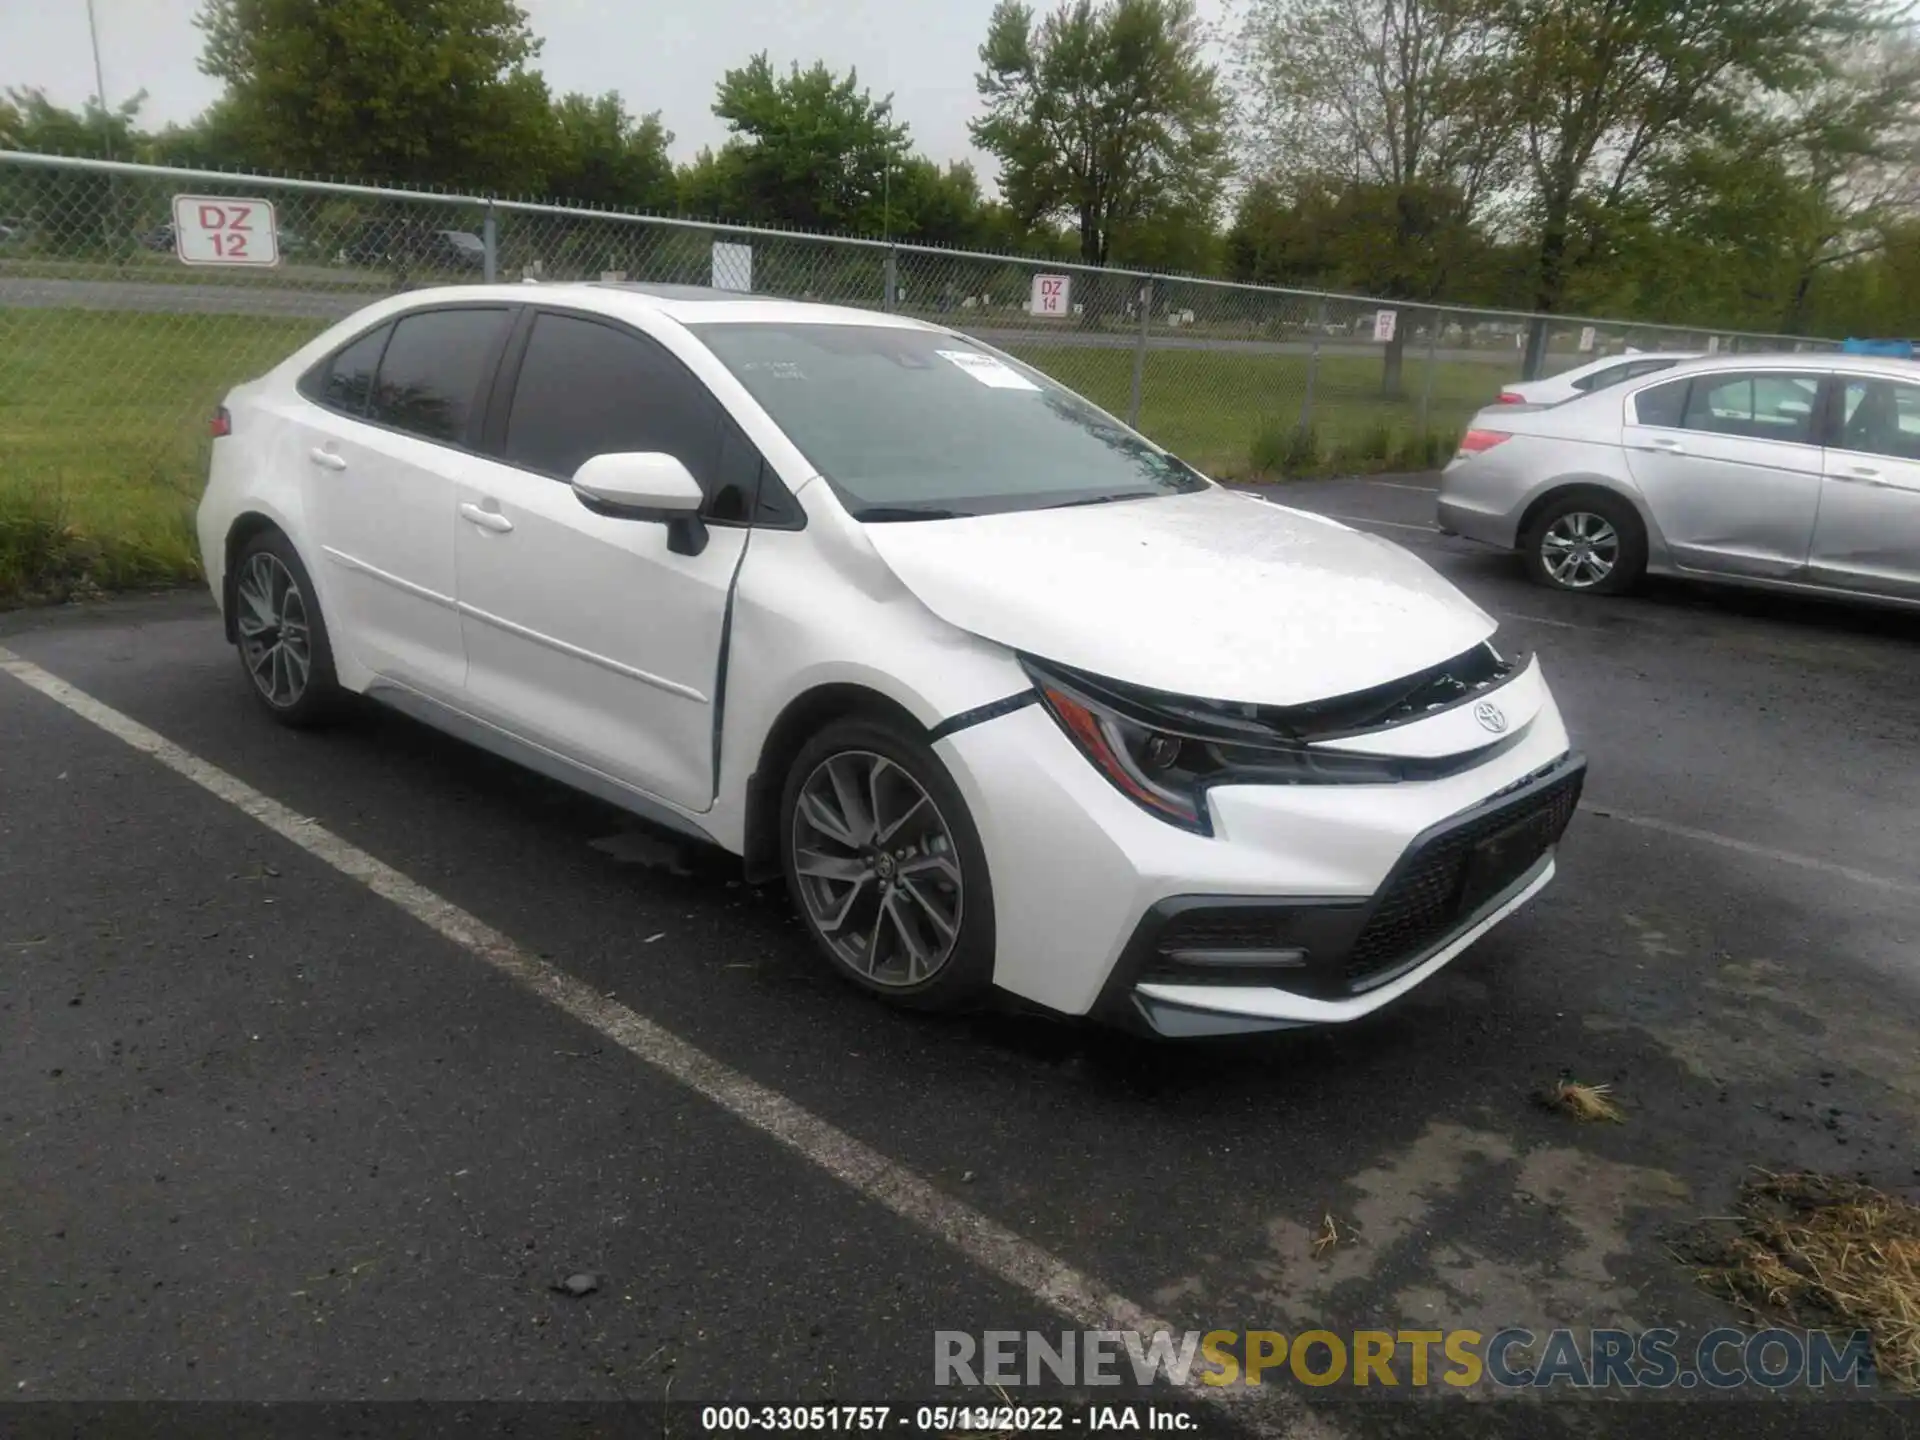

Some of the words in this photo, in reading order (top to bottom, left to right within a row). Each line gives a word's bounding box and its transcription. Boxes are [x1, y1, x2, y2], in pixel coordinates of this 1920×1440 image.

[198, 206, 253, 231] DZ
[207, 233, 249, 257] 12
[1042, 280, 1062, 295] DZ
[1043, 297, 1057, 311] 14
